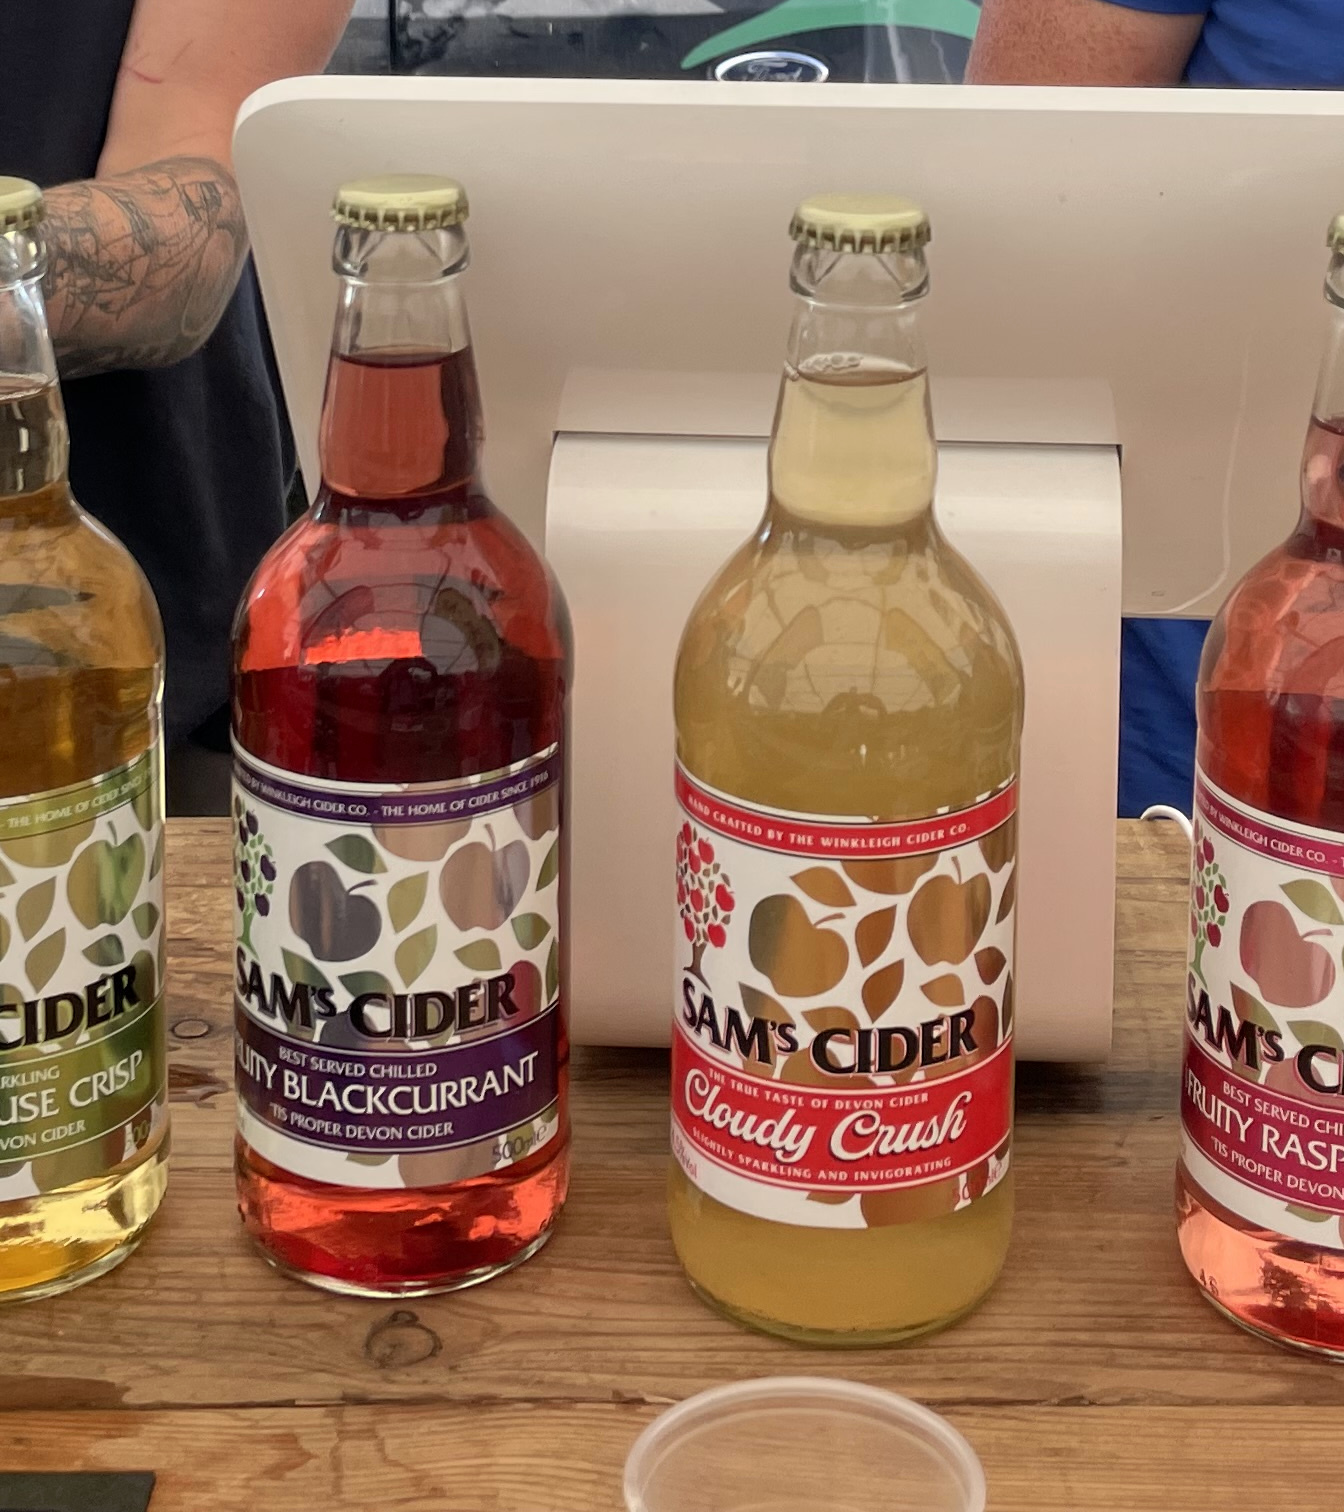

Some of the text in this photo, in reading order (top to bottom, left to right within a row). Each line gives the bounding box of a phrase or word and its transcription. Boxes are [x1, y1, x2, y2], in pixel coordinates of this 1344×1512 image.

[8, 816, 31, 829] THE
[35, 805, 73, 825] HOME
[74, 799, 90, 814] OF
[313, 799, 346, 813] CIDER
[381, 805, 404, 817] THE
[408, 802, 447, 817] HOME
[450, 798, 466, 811] OF
[468, 792, 500, 808] CIDER
[501, 781, 528, 799] SINCE
[530, 770, 549, 787] 1916
[688, 794, 710, 816] HAND
[713, 811, 762, 836] CRAFTED
[767, 829, 784, 841] BY
[789, 833, 813, 846] THE
[820, 834, 901, 848] WINKLEIGH
[906, 827, 945, 845] CIDER
[1219, 812, 1268, 847] WINKLEIGH
[1270, 839, 1304, 859] CIDER
[349, 973, 521, 1040] CIDER
[279, 1045, 438, 1079] BEST SERVED CHILLED
[810, 1008, 979, 1076] CIDER
[68, 1049, 143, 1109] CRISP
[283, 1051, 539, 1115] BLACKCURRANT
[708, 1068, 929, 1110] THE TRUE TASTE OF DEVON CIDER
[290, 1111, 454, 1140] PROPER DEVON CIDER
[685, 1068, 817, 1163] Cloudy
[830, 1091, 973, 1161] Crush
[1187, 1068, 1253, 1143] FRUITY
[1223, 1080, 1252, 1107] BEST
[1255, 1099, 1310, 1129] SERVED
[41, 1119, 86, 1143] CIDER
[692, 1126, 734, 1160] SLIGHTLY
[738, 1153, 811, 1179] SPARKLING
[817, 1170, 848, 1181] AND
[854, 1157, 952, 1182] INVIGORATING
[1231, 1146, 1284, 1185] PROPER
